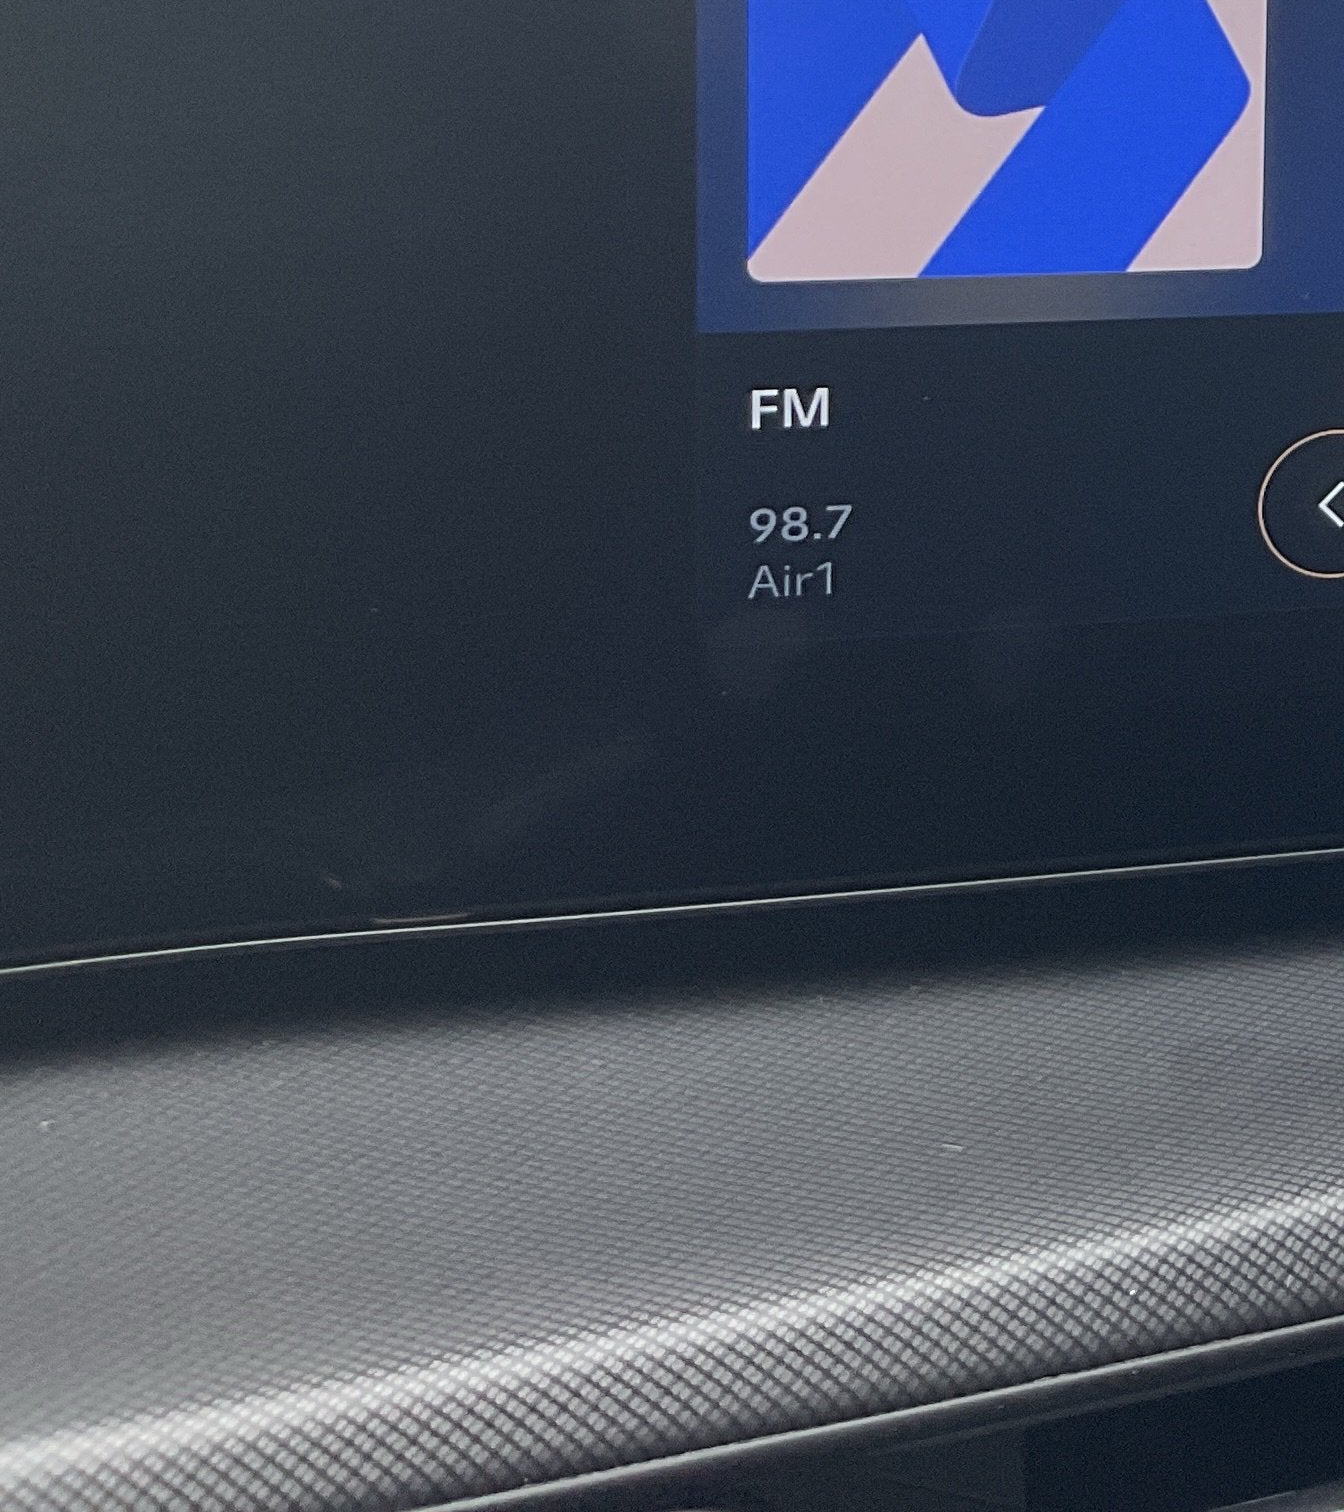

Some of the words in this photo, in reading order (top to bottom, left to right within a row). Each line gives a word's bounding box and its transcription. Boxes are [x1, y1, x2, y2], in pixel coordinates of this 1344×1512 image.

[749, 386, 831, 431] FM
[748, 503, 854, 545] 98.7
[746, 560, 836, 601] Air1
